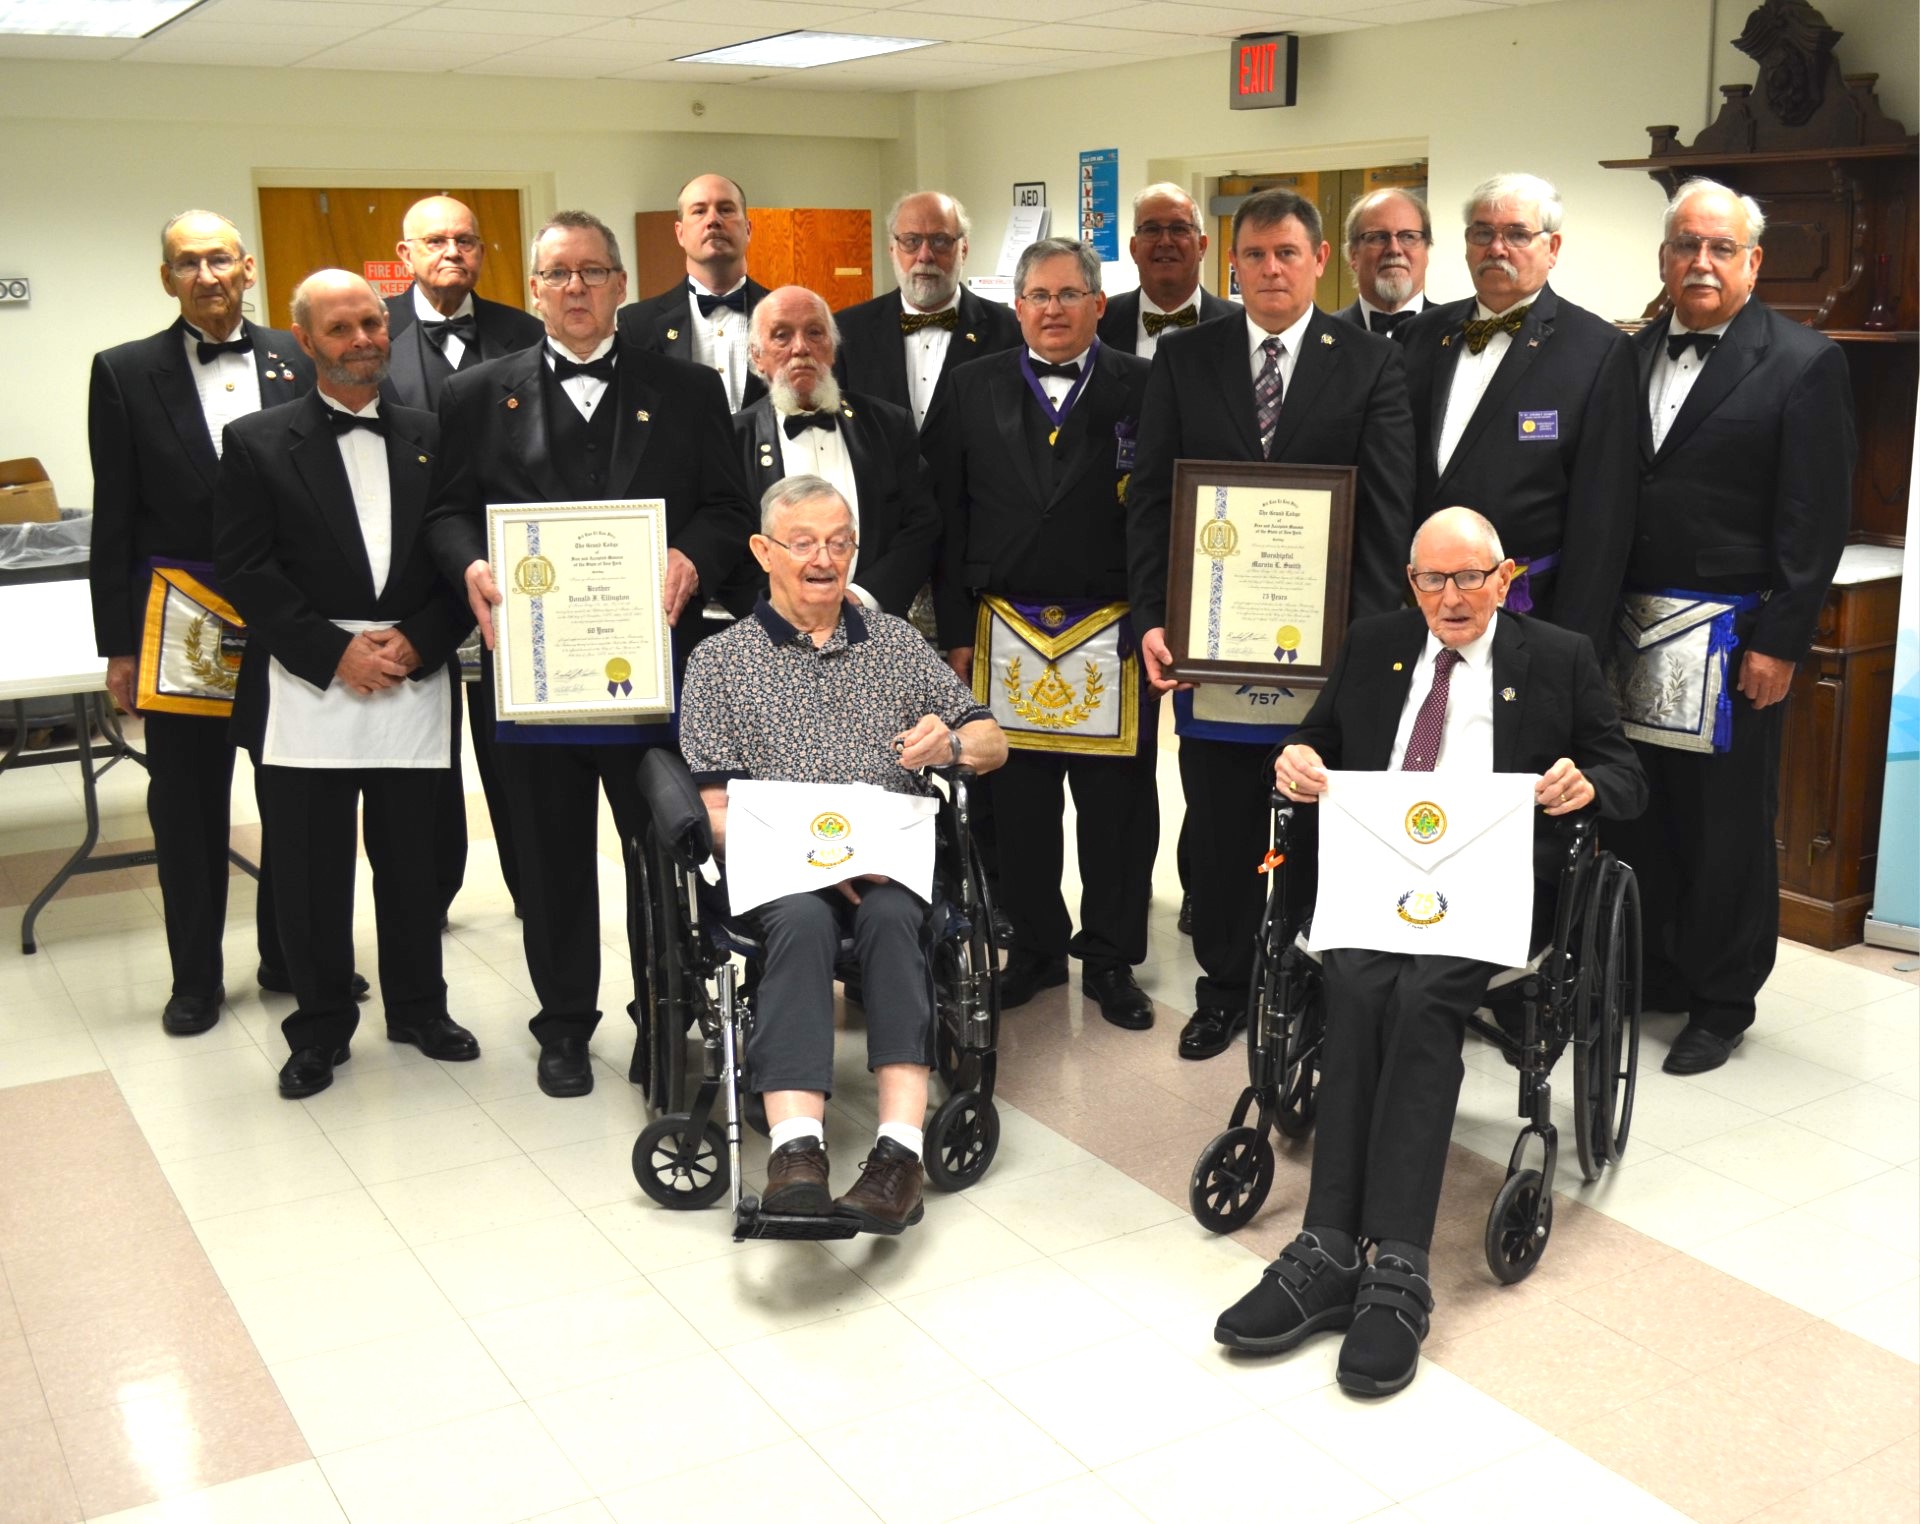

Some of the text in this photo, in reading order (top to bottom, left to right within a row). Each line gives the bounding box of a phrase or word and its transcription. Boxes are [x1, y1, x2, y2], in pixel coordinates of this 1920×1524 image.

[1239, 43, 1277, 95] EXIT
[1021, 190, 1039, 207] AED
[368, 263, 414, 278] FIRE DO
[1261, 551, 1294, 560] Worshipful
[601, 594, 630, 602] Ellington
[1271, 593, 1288, 601] Years
[596, 626, 614, 635] Years
[1249, 693, 1280, 705] 757
[1413, 893, 1435, 909] 75
